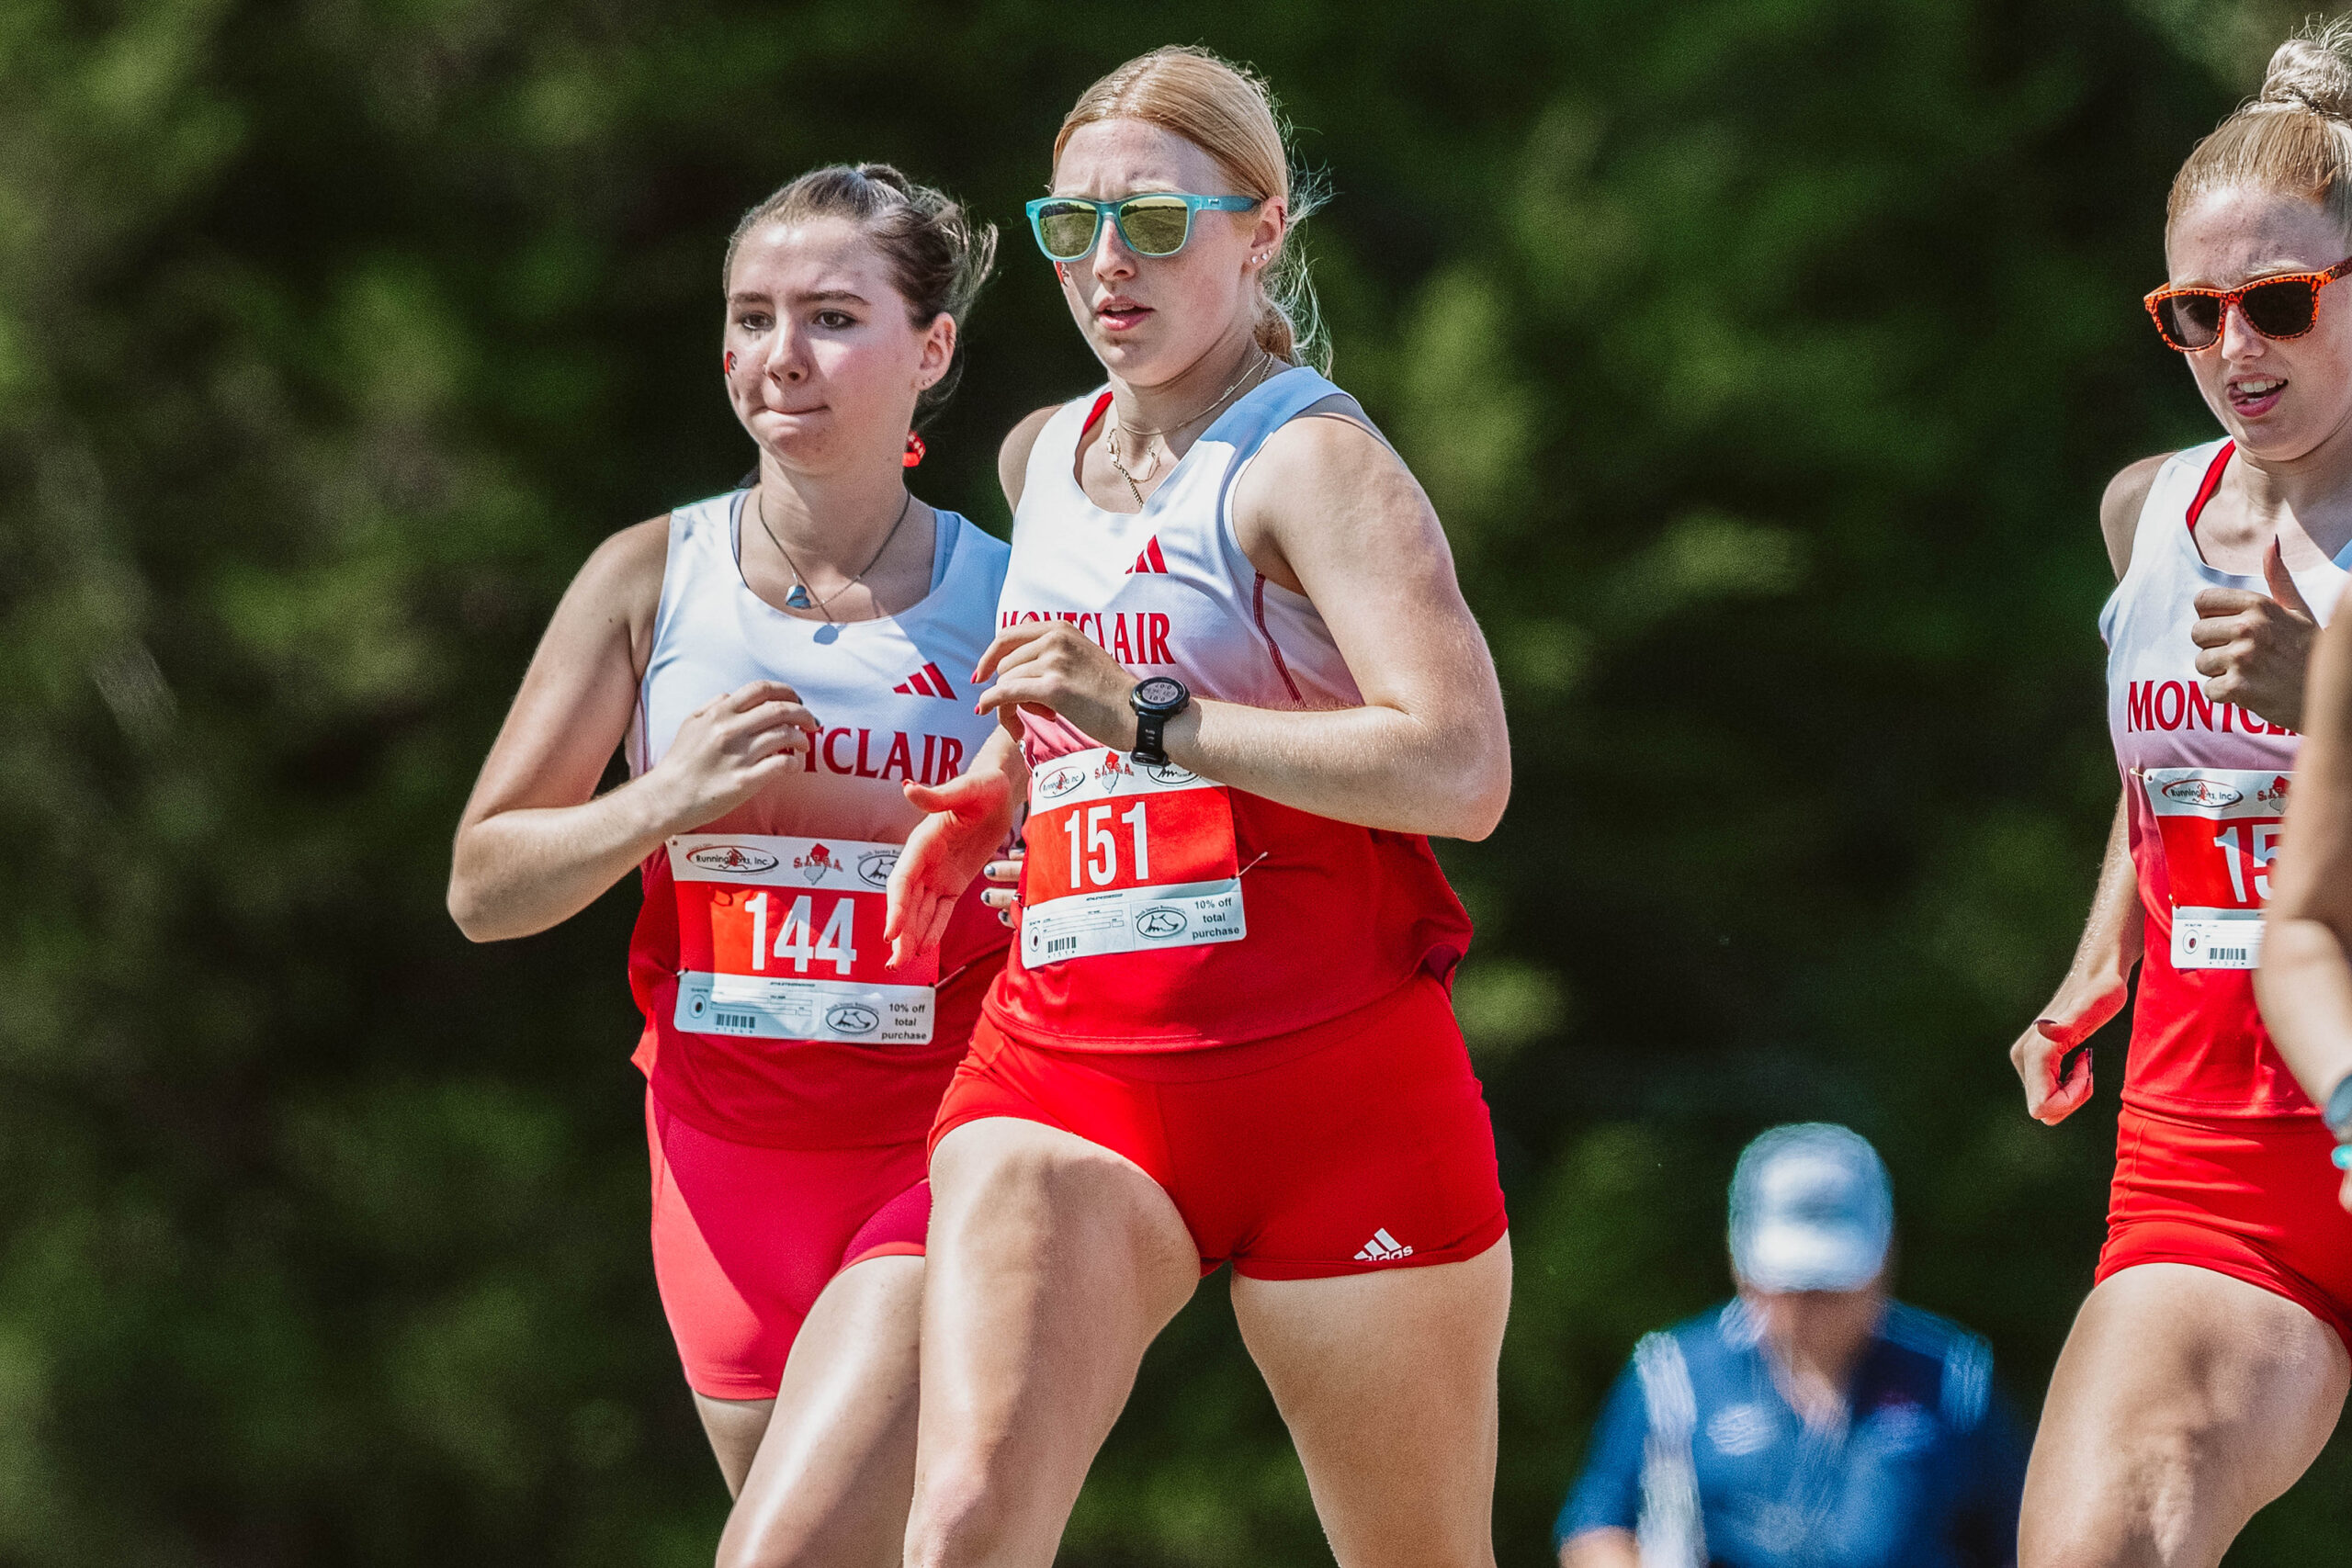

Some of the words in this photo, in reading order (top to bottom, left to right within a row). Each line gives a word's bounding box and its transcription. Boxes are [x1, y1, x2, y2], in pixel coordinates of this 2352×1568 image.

[777, 726, 964, 786] TCLAIR
[1064, 801, 1149, 889] 151
[753, 856, 771, 866] Inc.
[1194, 899, 1216, 910] 10%
[1217, 897, 1233, 908] off
[1203, 912, 1227, 924] total
[744, 891, 857, 976] 144
[1192, 926, 1240, 942] purchase
[888, 1002, 910, 1012] 10%
[911, 1003, 926, 1013] off
[895, 1017, 917, 1027] total
[881, 1031, 928, 1041] purchase
